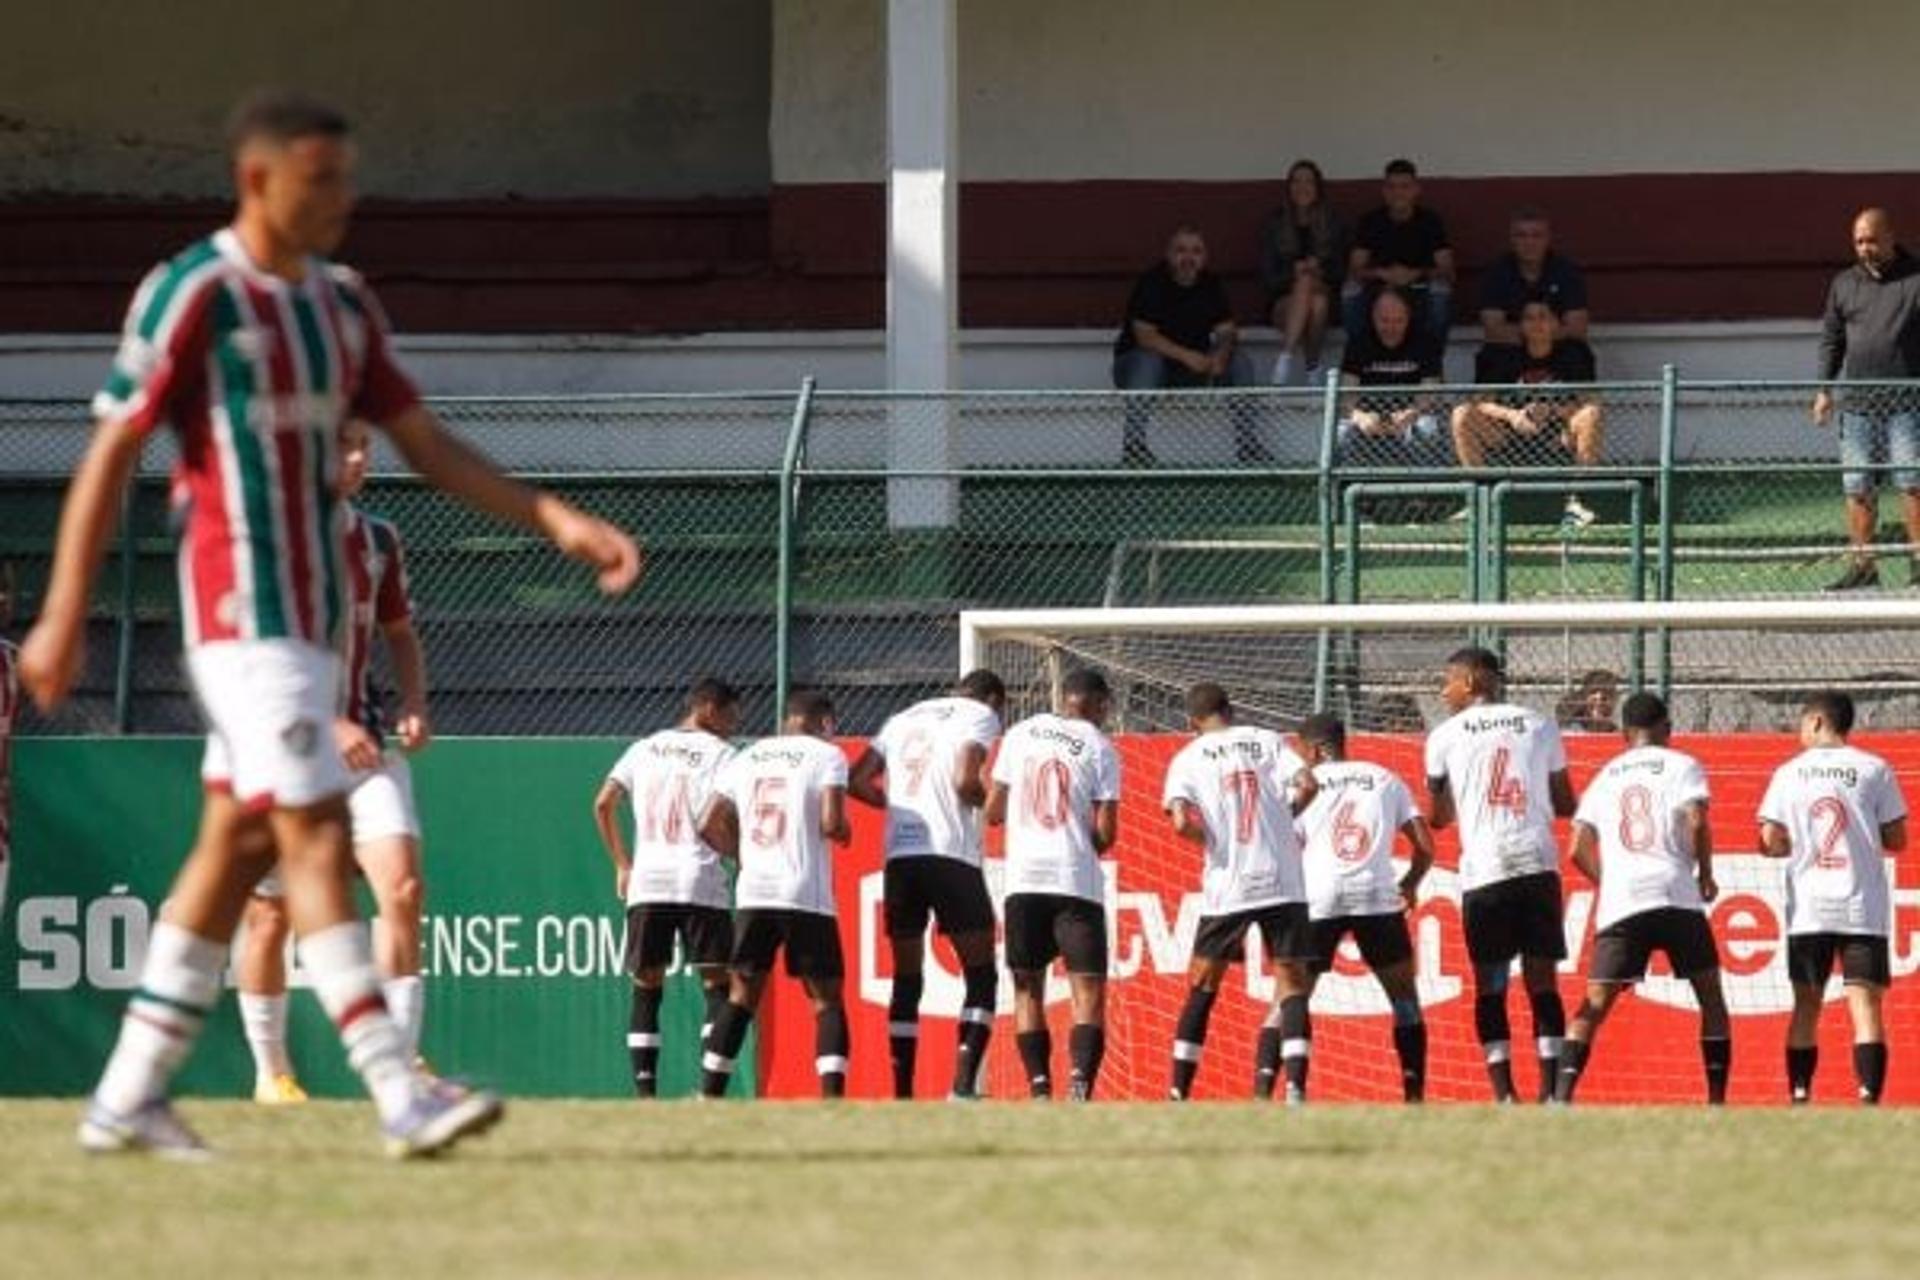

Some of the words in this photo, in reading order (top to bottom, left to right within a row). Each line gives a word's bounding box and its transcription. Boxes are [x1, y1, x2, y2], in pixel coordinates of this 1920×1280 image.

[752, 776, 787, 846] 5
[1488, 747, 1526, 820] 4
[1619, 784, 1656, 851] 8
[1332, 799, 1371, 862] 6
[1810, 796, 1848, 868] 2
